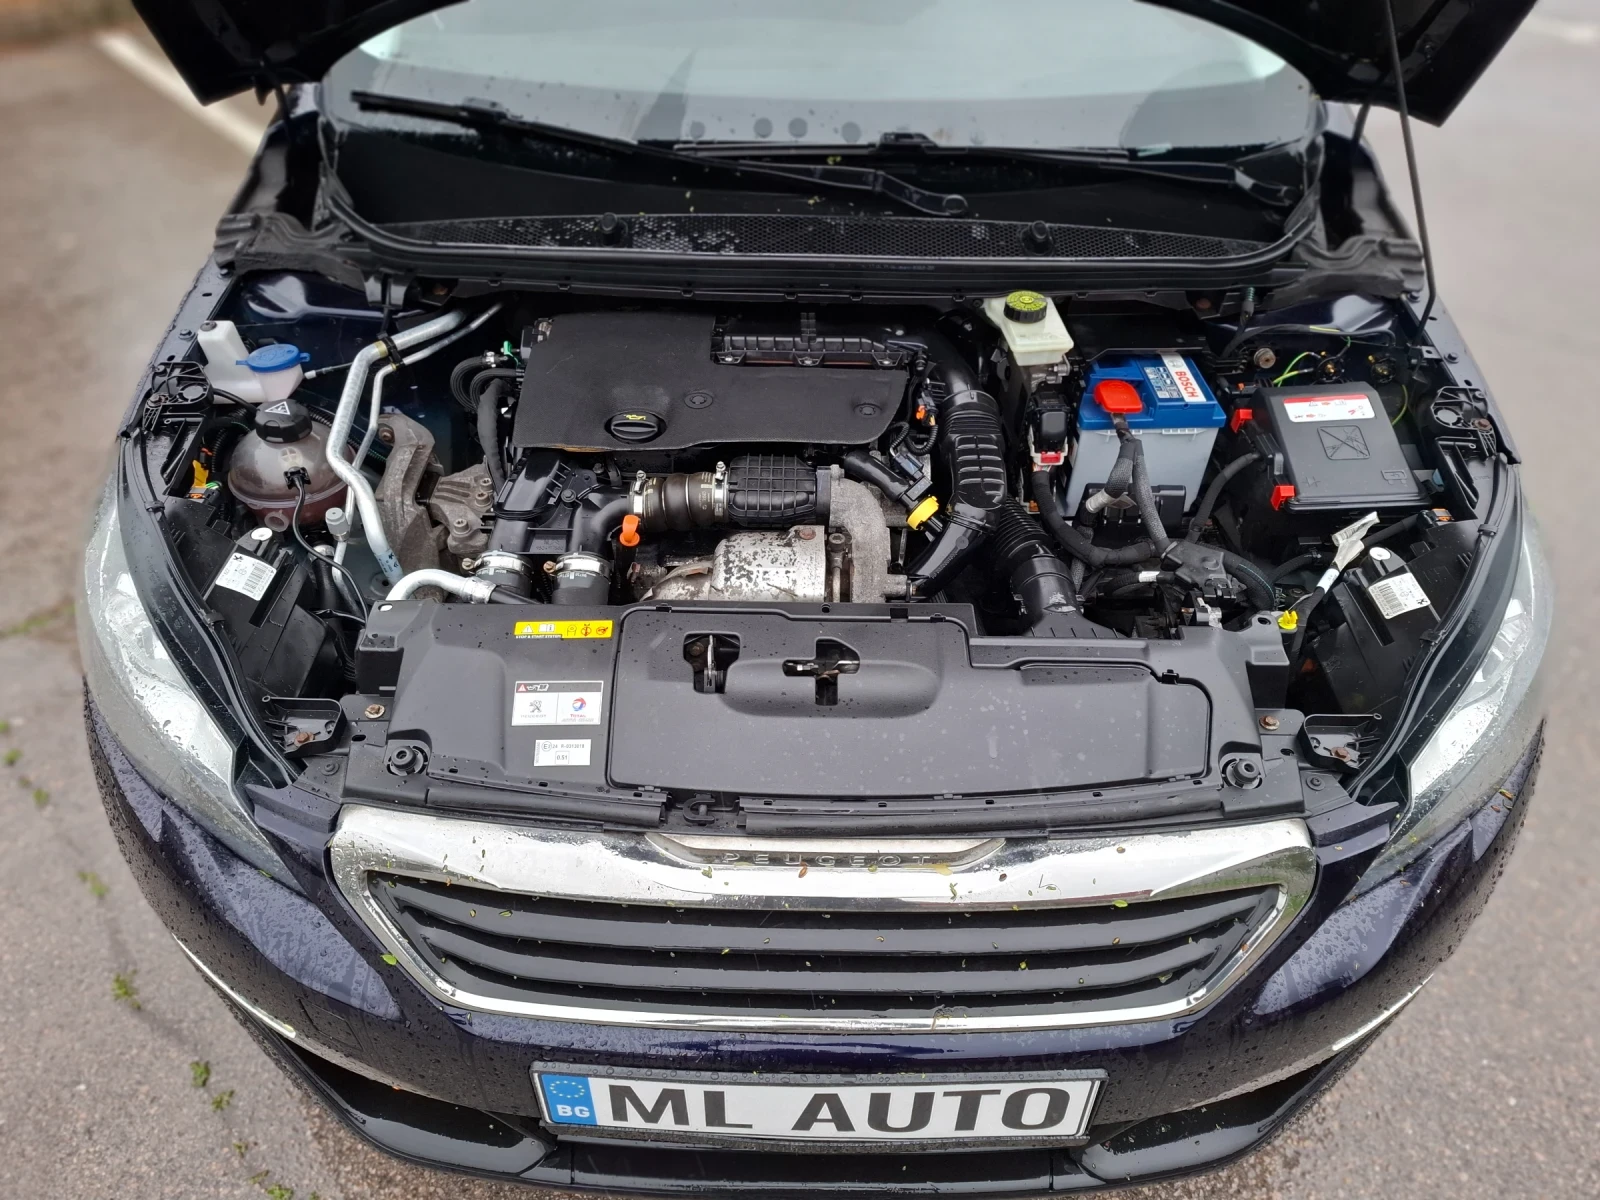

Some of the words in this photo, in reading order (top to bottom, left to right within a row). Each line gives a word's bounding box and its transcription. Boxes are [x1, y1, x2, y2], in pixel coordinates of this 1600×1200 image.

[1174, 370, 1199, 398] BOSCH
[721, 852, 931, 867] PEUGEOT
[556, 1104, 590, 1118] BG
[608, 1083, 752, 1129] ML
[791, 1087, 1071, 1132] AUTO
